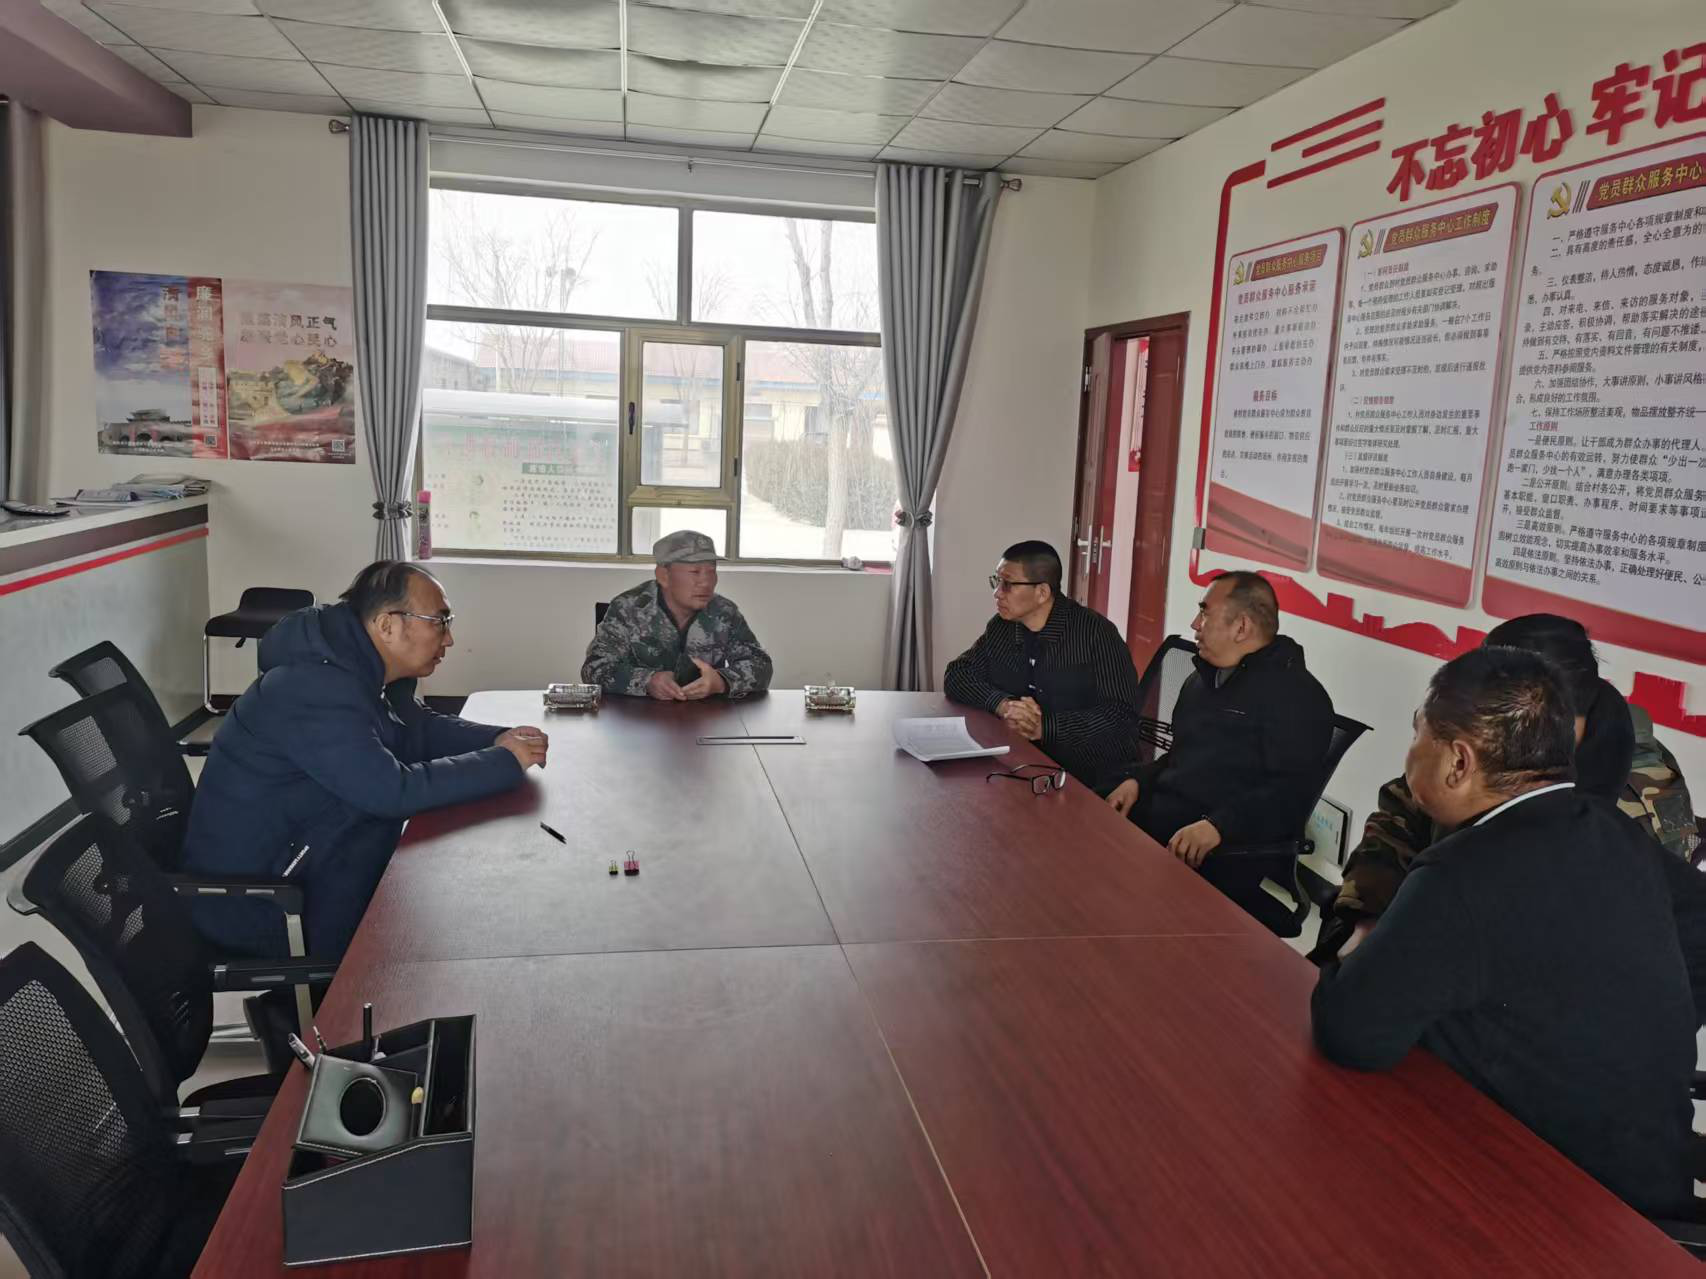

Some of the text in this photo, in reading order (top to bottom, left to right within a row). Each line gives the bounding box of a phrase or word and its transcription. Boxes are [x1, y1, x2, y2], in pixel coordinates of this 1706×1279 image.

[1387, 42, 1706, 201] 不忘初心 牢记
[1599, 160, 1703, 201] 党员群众服务中心
[1528, 421, 1558, 431] 工作原则
